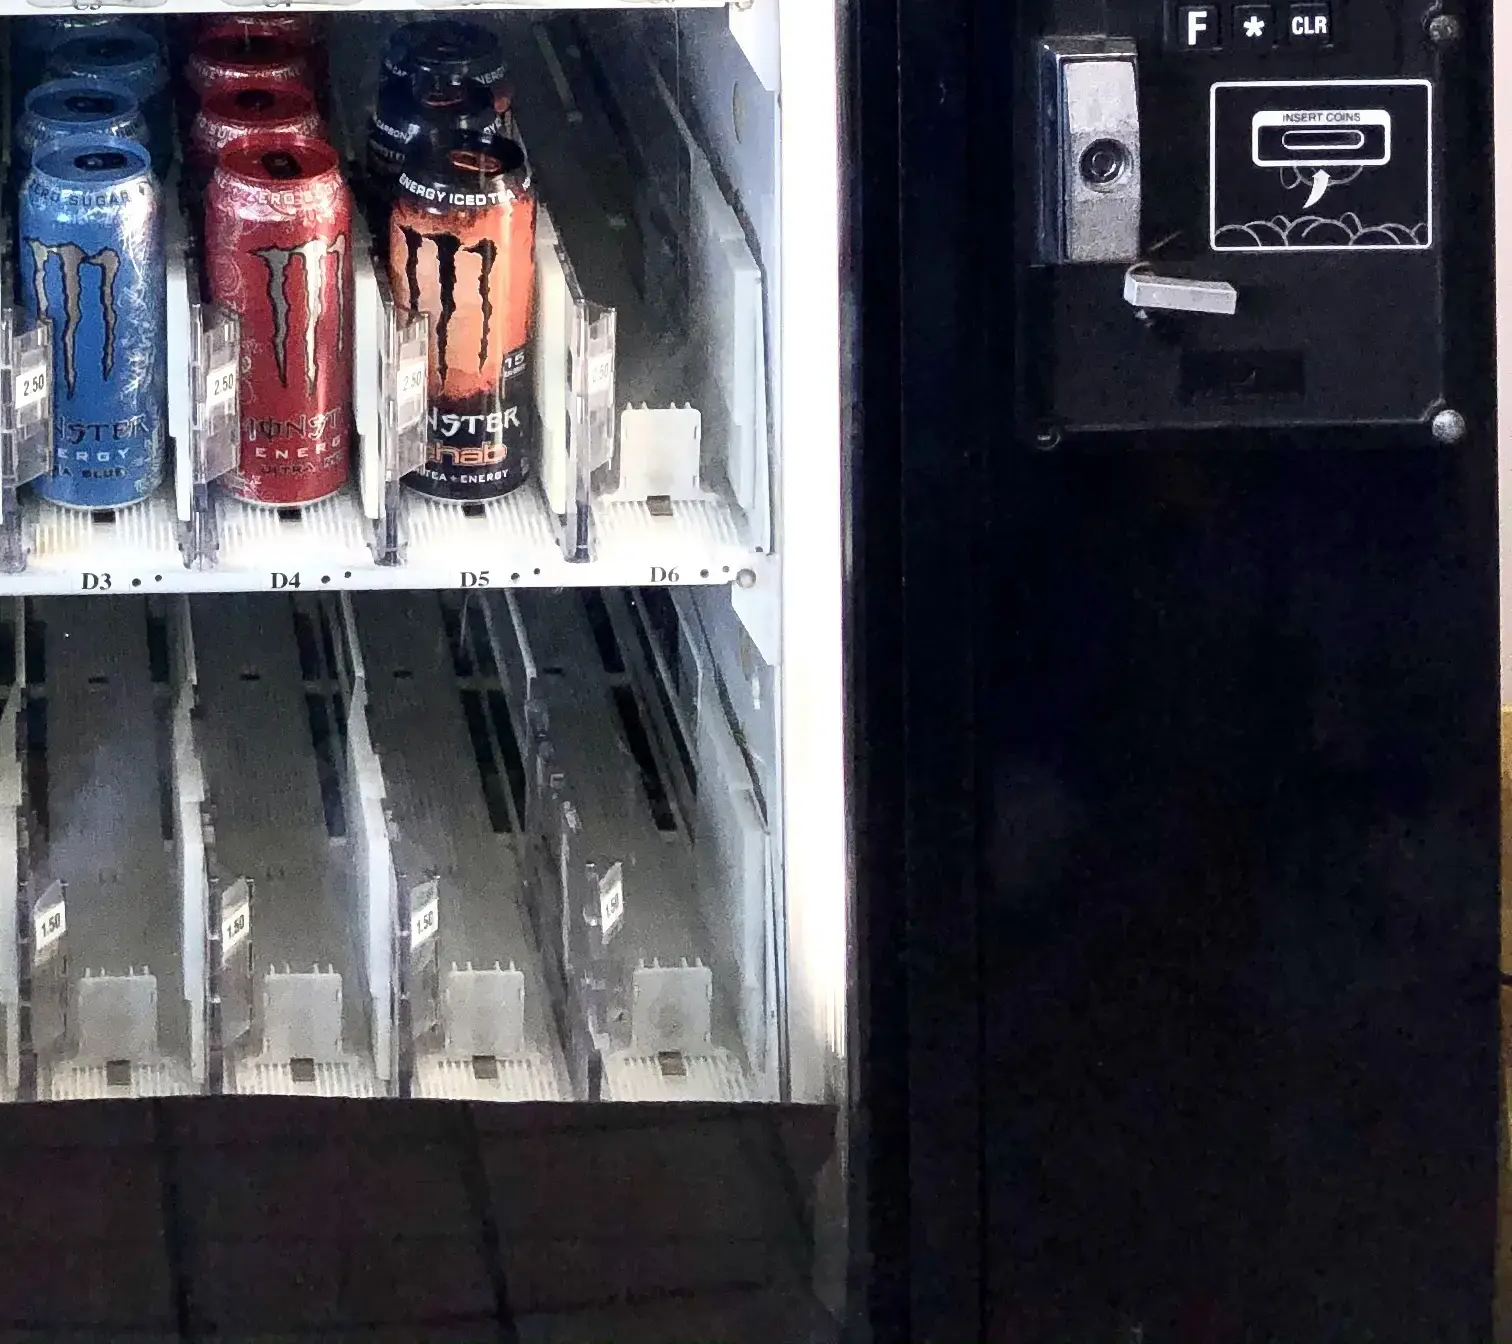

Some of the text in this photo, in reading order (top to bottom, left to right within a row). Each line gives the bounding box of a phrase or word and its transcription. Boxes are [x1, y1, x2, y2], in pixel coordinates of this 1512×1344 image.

[1187, 10, 1328, 46] F CLR
[1282, 112, 1361, 123] INSERT COINS
[68, 189, 133, 208] SUGAR
[247, 189, 296, 206] ZERO
[398, 172, 517, 206] ENERGY ICED TEA
[23, 373, 46, 397] 2.50
[214, 373, 234, 396] 2.50
[402, 370, 423, 392] 2.50
[53, 413, 150, 445] NSTER
[426, 405, 521, 437] NSTER
[425, 468, 509, 484] TEA ENERGY
[81, 572, 113, 591] D3
[270, 571, 301, 590] D4
[459, 569, 490, 588] D5
[649, 565, 680, 583] D6
[604, 893, 620, 918] 1.50
[40, 912, 61, 938] 1.50
[225, 913, 245, 938] 1.50
[416, 910, 434, 935] 1.50
